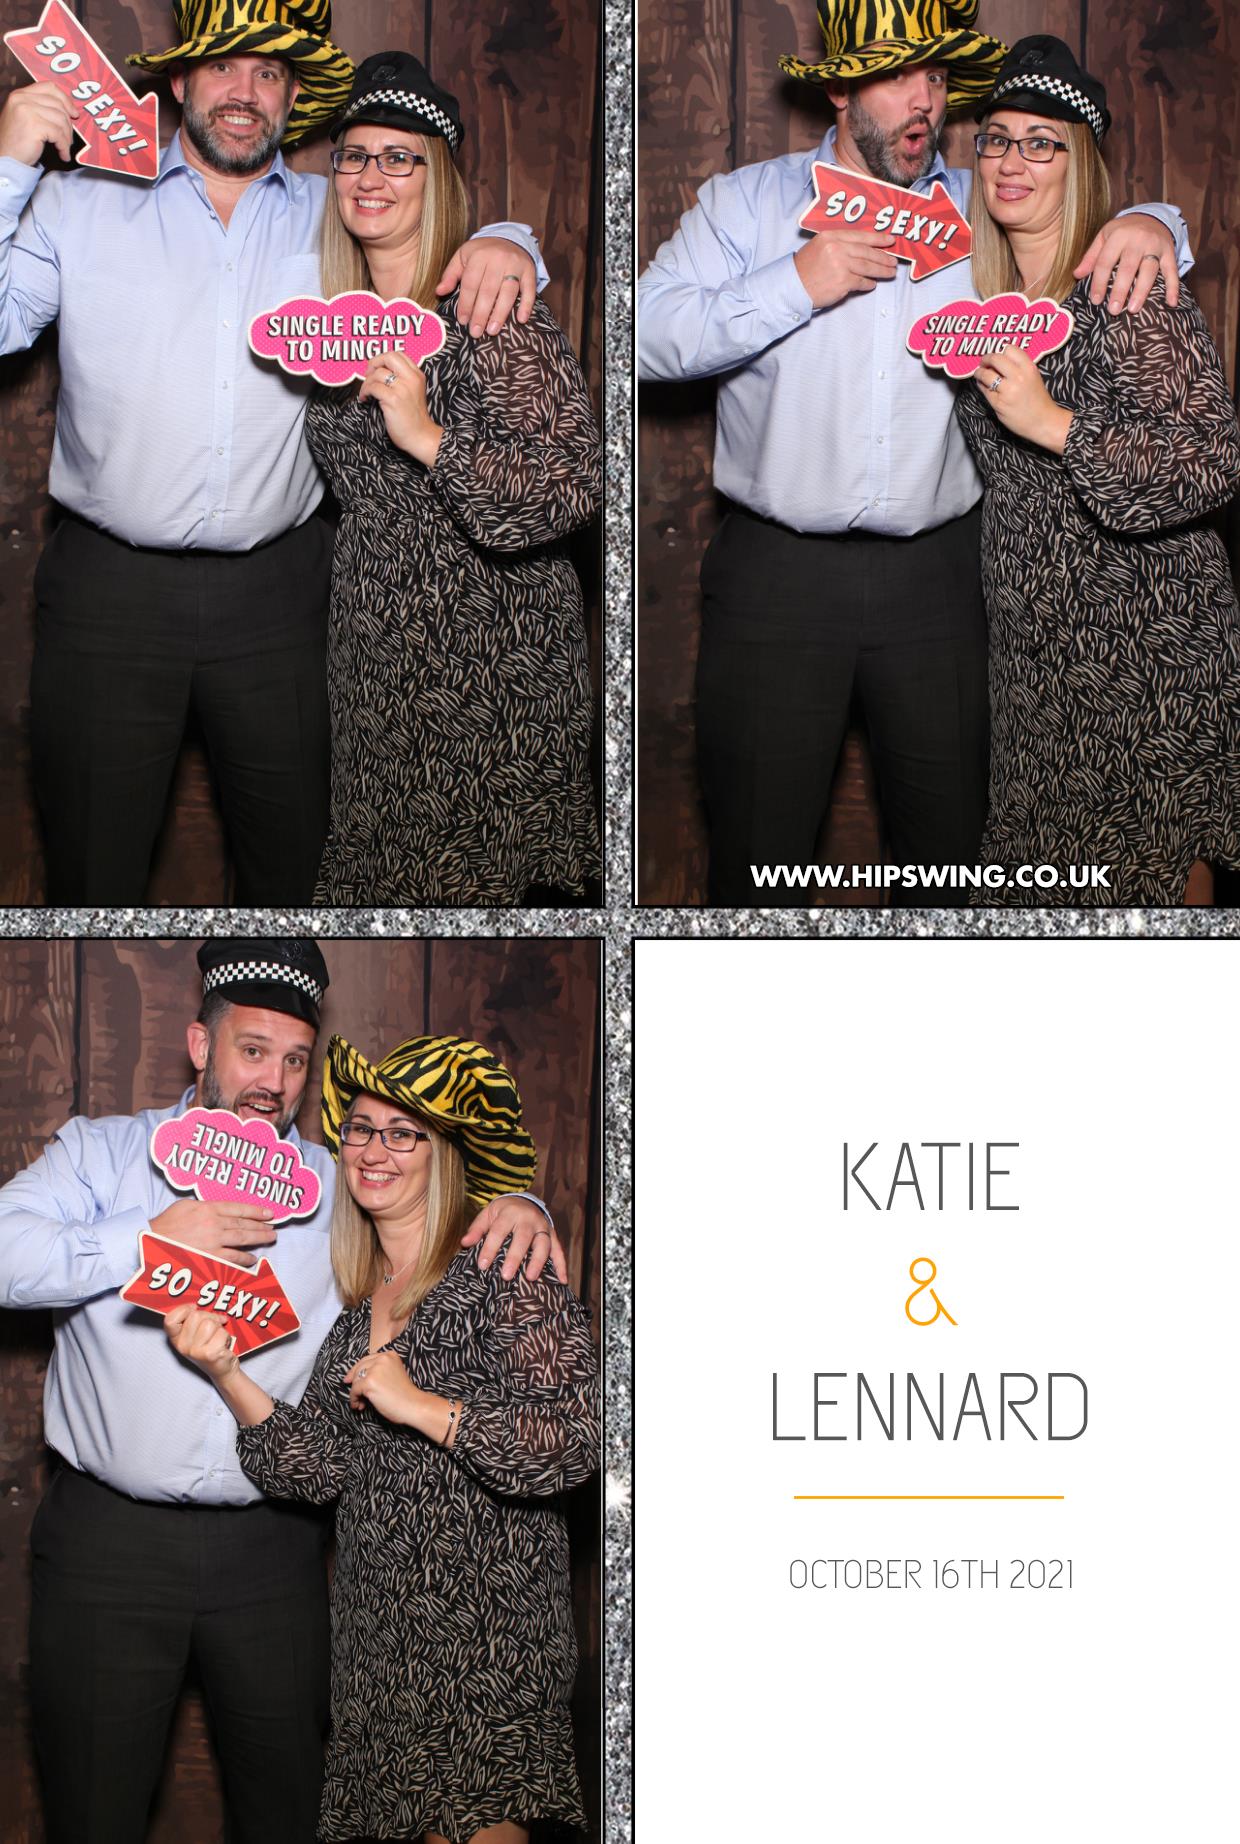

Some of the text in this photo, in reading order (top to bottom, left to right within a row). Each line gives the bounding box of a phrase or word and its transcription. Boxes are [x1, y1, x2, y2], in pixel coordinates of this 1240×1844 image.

[35, 35, 148, 156] SO SEXY!
[825, 191, 959, 250] SO SEXY!
[267, 314, 426, 337] SINGLE READY
[286, 339, 314, 361] TO
[924, 313, 1060, 335] SINGLE READY
[930, 336, 955, 356] TO
[164, 1143, 305, 1210] SINGLE READY
[190, 1123, 296, 1180] TO MINGLE
[149, 1262, 281, 1328] SO SEXY!
